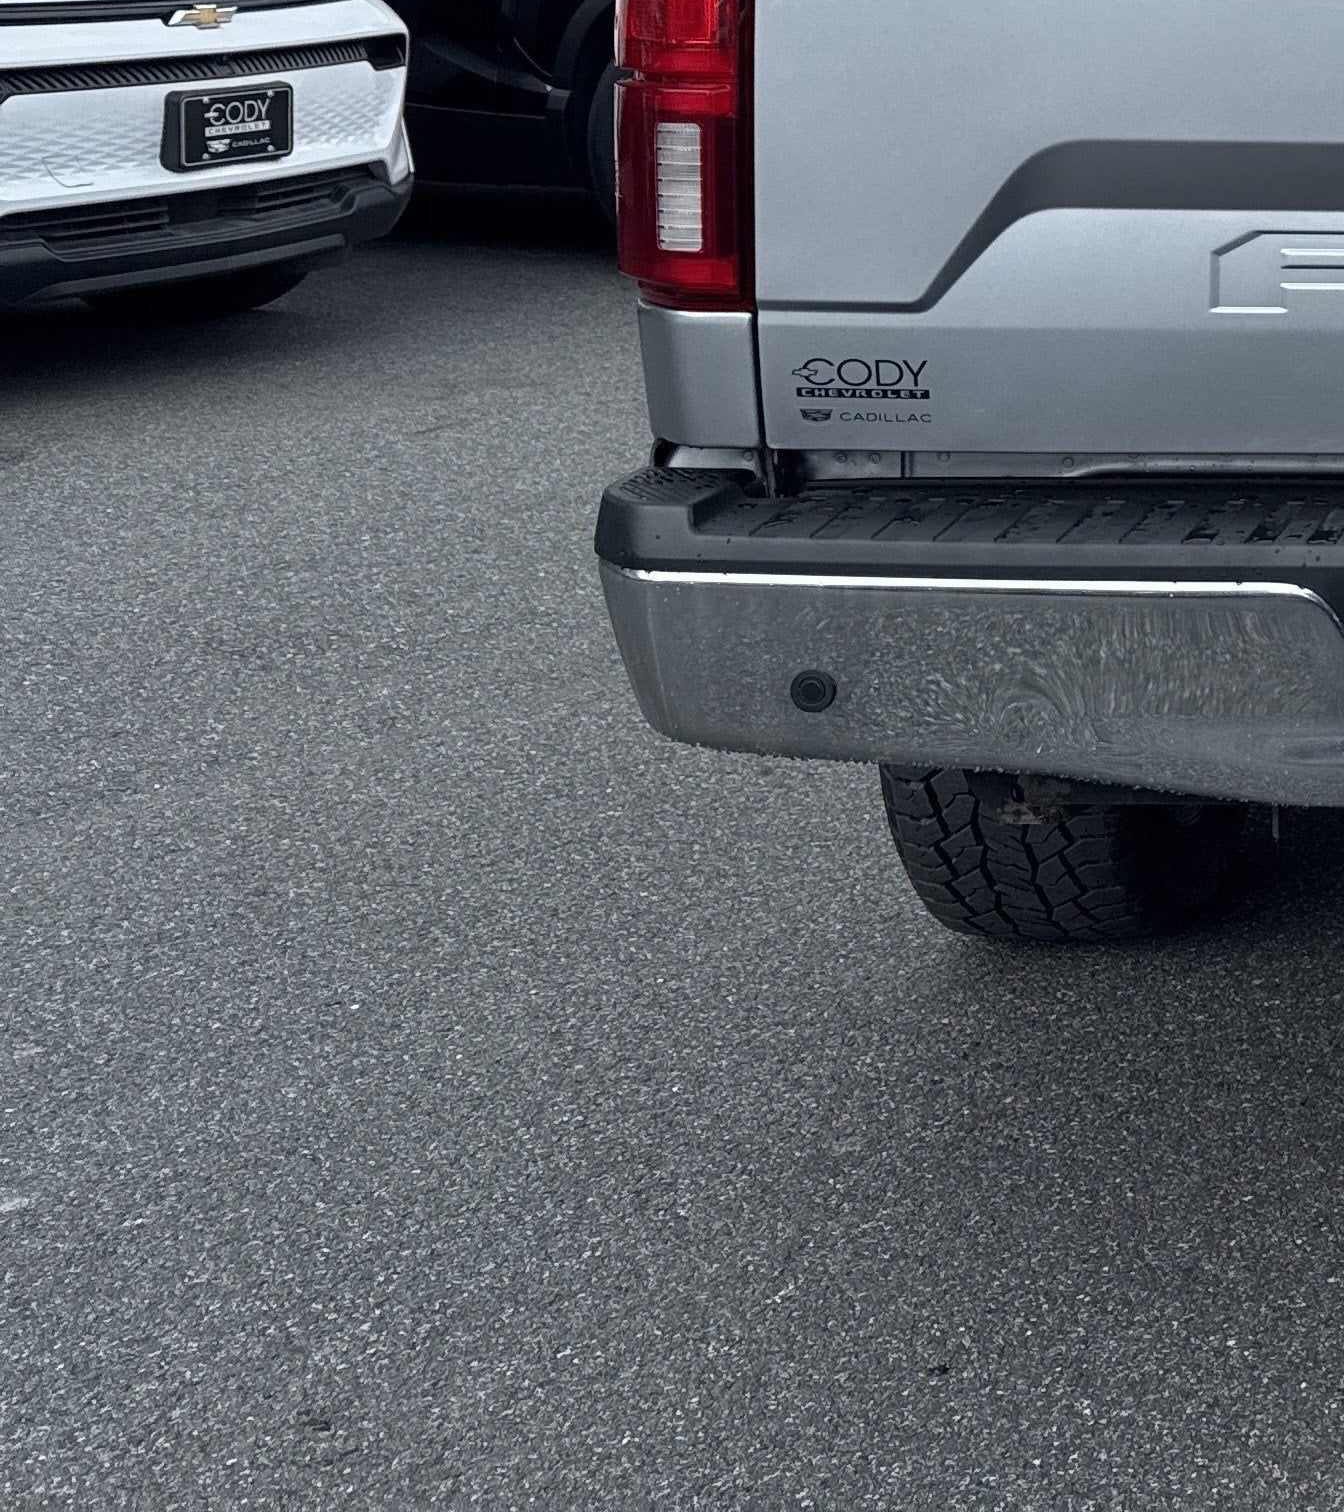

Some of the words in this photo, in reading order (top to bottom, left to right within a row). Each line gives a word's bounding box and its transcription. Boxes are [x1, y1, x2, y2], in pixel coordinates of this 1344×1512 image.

[204, 99, 270, 125] CODY
[791, 357, 929, 387] CODY
[800, 387, 926, 399] CHEVROLET
[839, 411, 933, 424] CADILLAC
